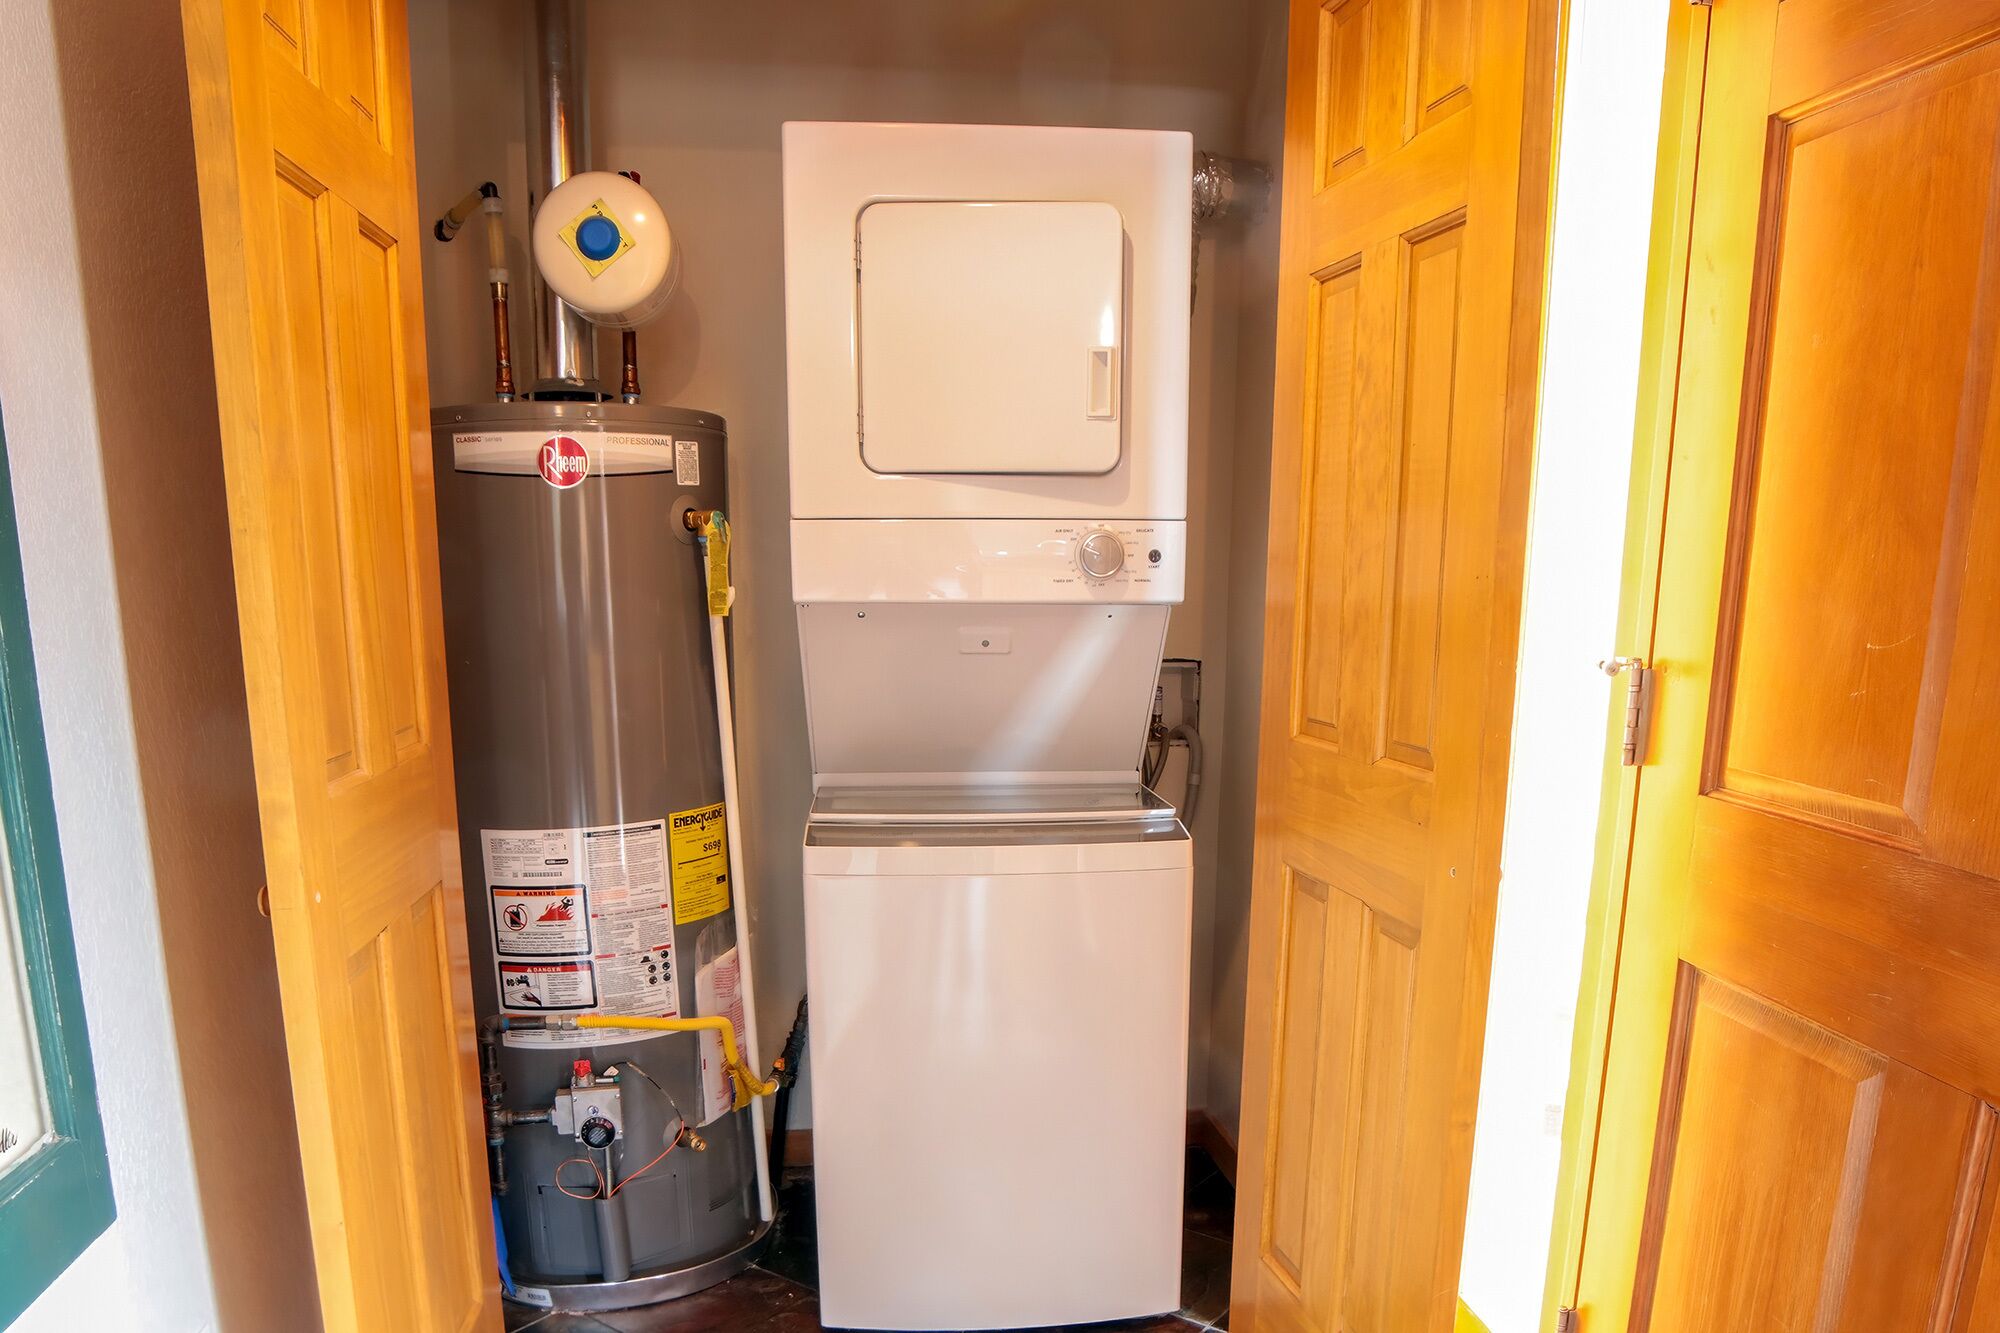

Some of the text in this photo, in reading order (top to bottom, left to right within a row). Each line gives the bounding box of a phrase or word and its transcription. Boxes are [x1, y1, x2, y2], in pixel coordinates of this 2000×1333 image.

[455, 436, 481, 444] CLASSIC
[606, 436, 670, 447] PROFESSIONAL
[542, 434, 587, 480] Rheem
